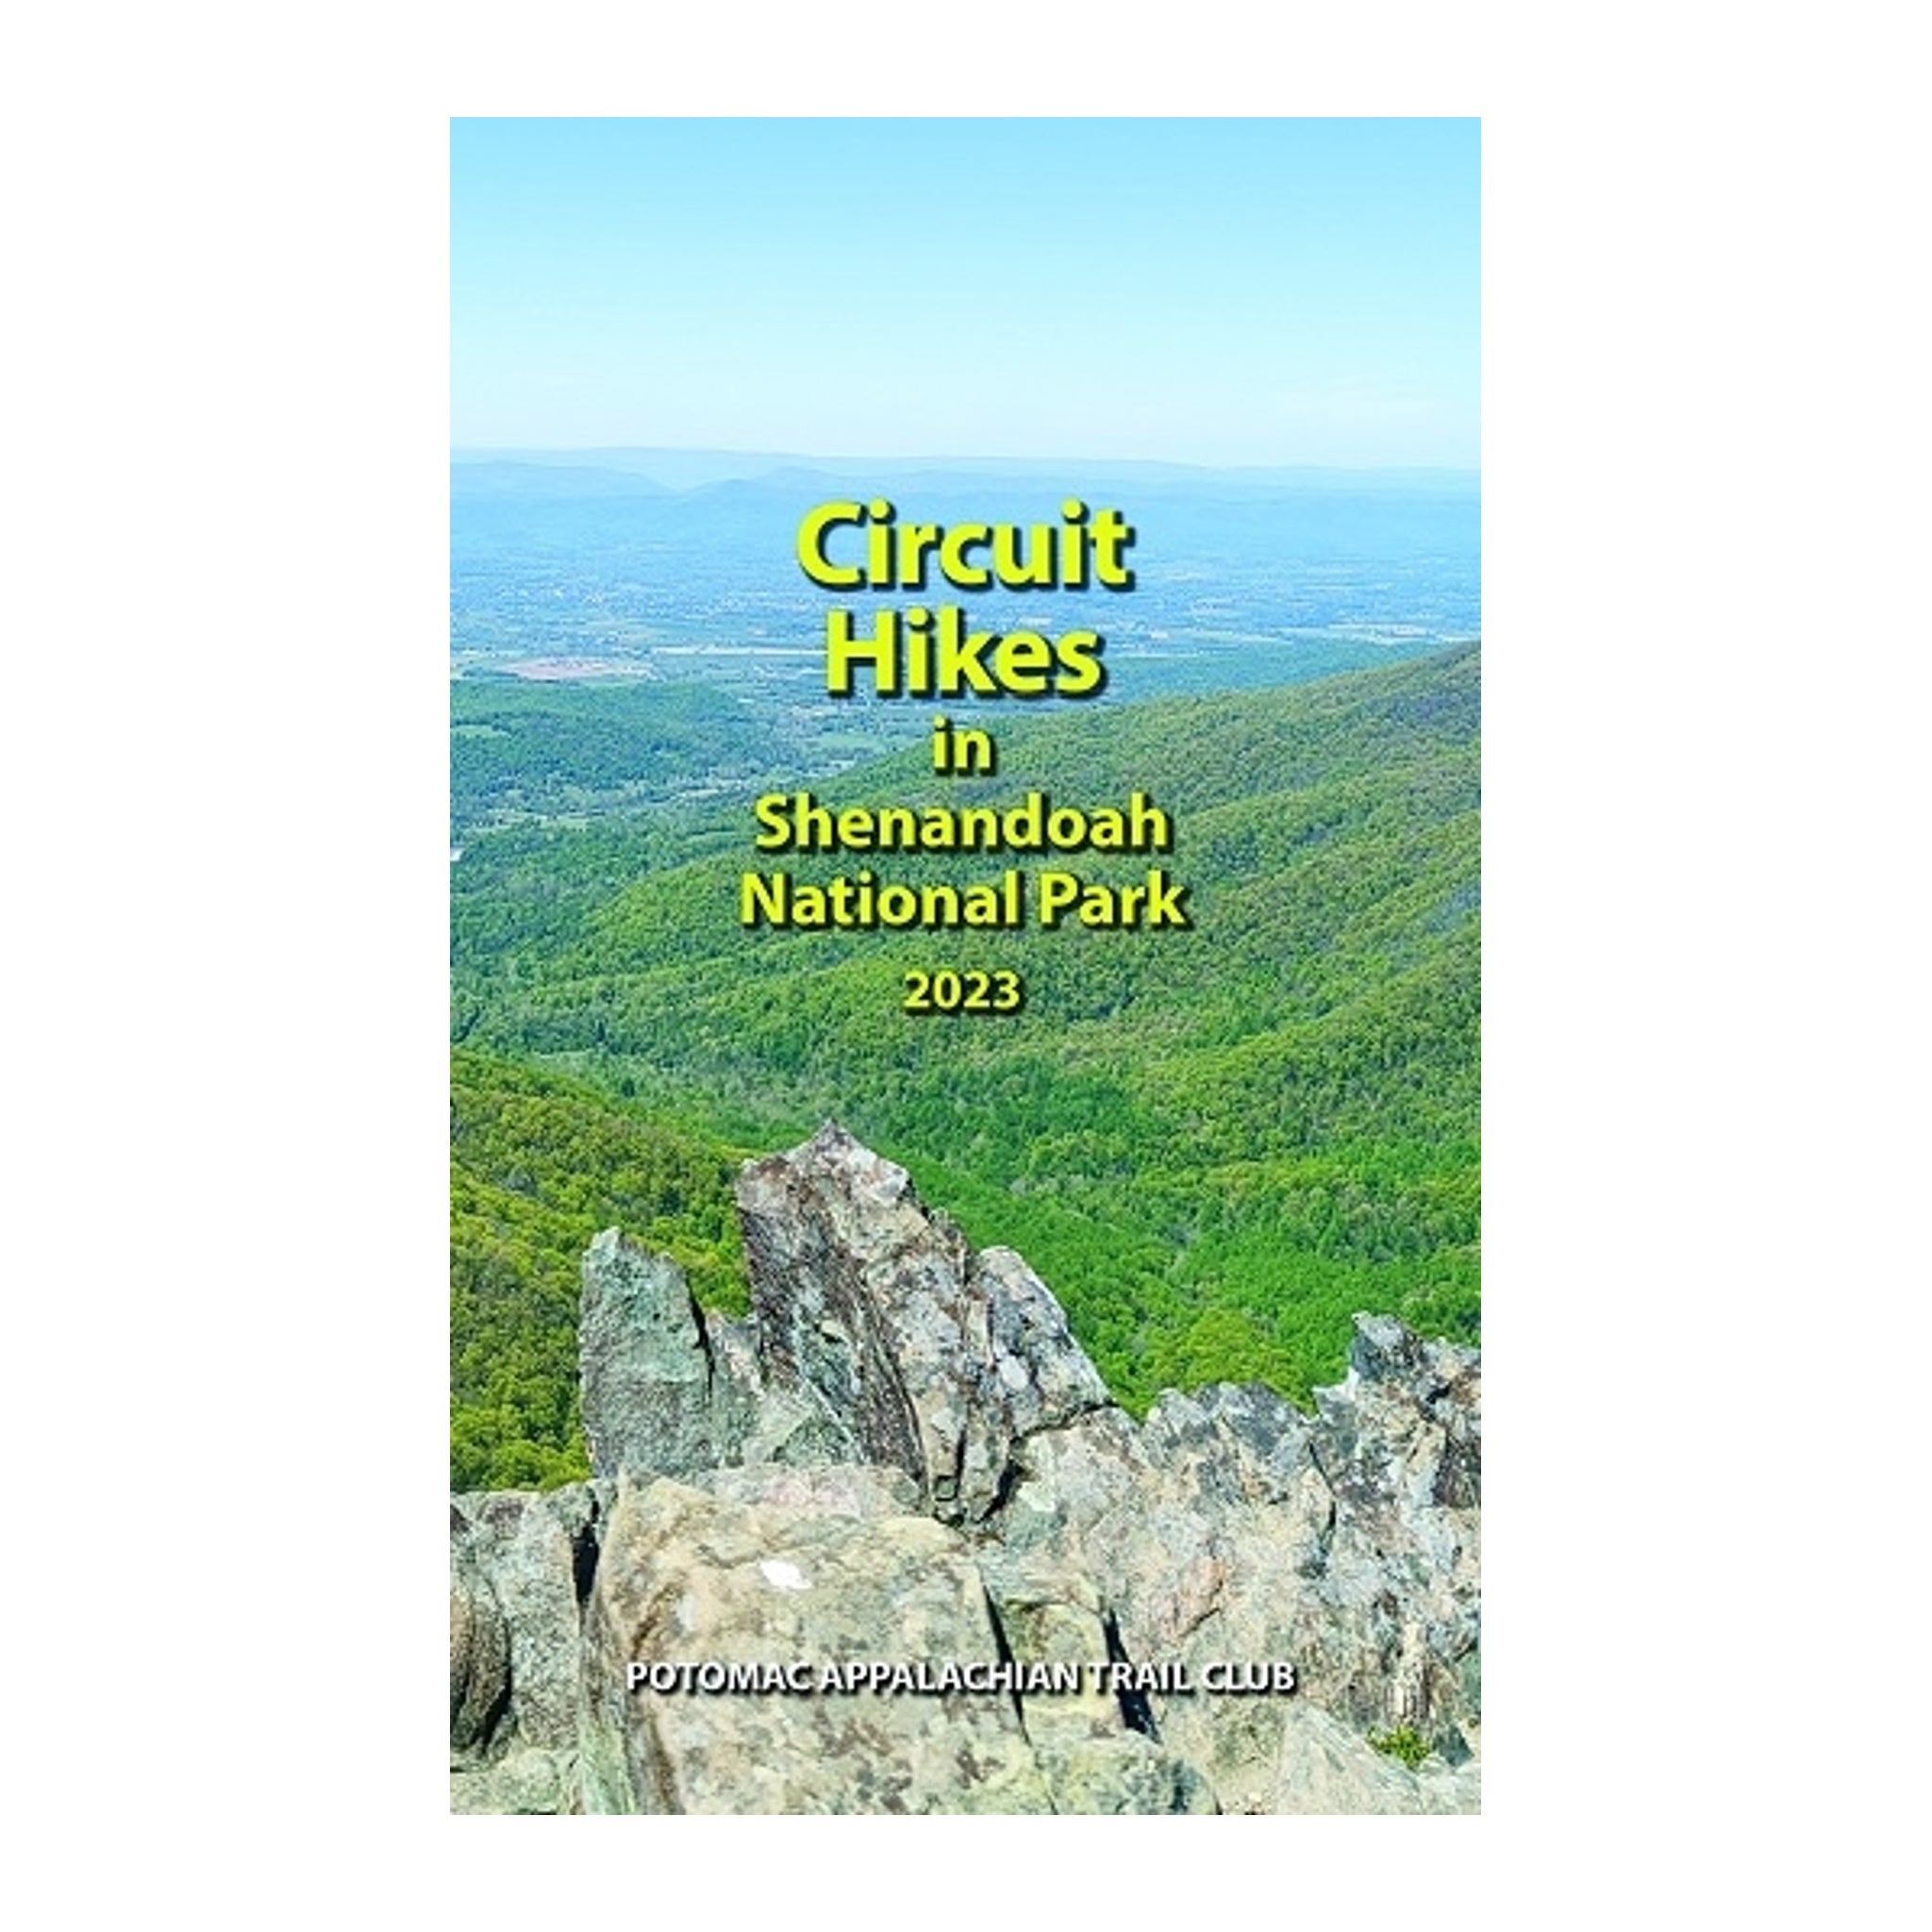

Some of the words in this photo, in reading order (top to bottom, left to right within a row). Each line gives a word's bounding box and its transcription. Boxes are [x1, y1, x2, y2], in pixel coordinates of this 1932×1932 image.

[796, 498, 1129, 587] Circuit
[825, 605, 1102, 693] Hikes
[932, 716, 991, 770] in
[755, 792, 1168, 848] Shenandoah
[740, 871, 1021, 925] National
[1039, 871, 1186, 925] Park
[903, 970, 1021, 1010] 2023
[626, 1661, 811, 1691] POTOMAC
[821, 1661, 1081, 1691] APPALACHIAN
[1089, 1661, 1191, 1691] TRAIL
[1203, 1661, 1295, 1691] CLUB
